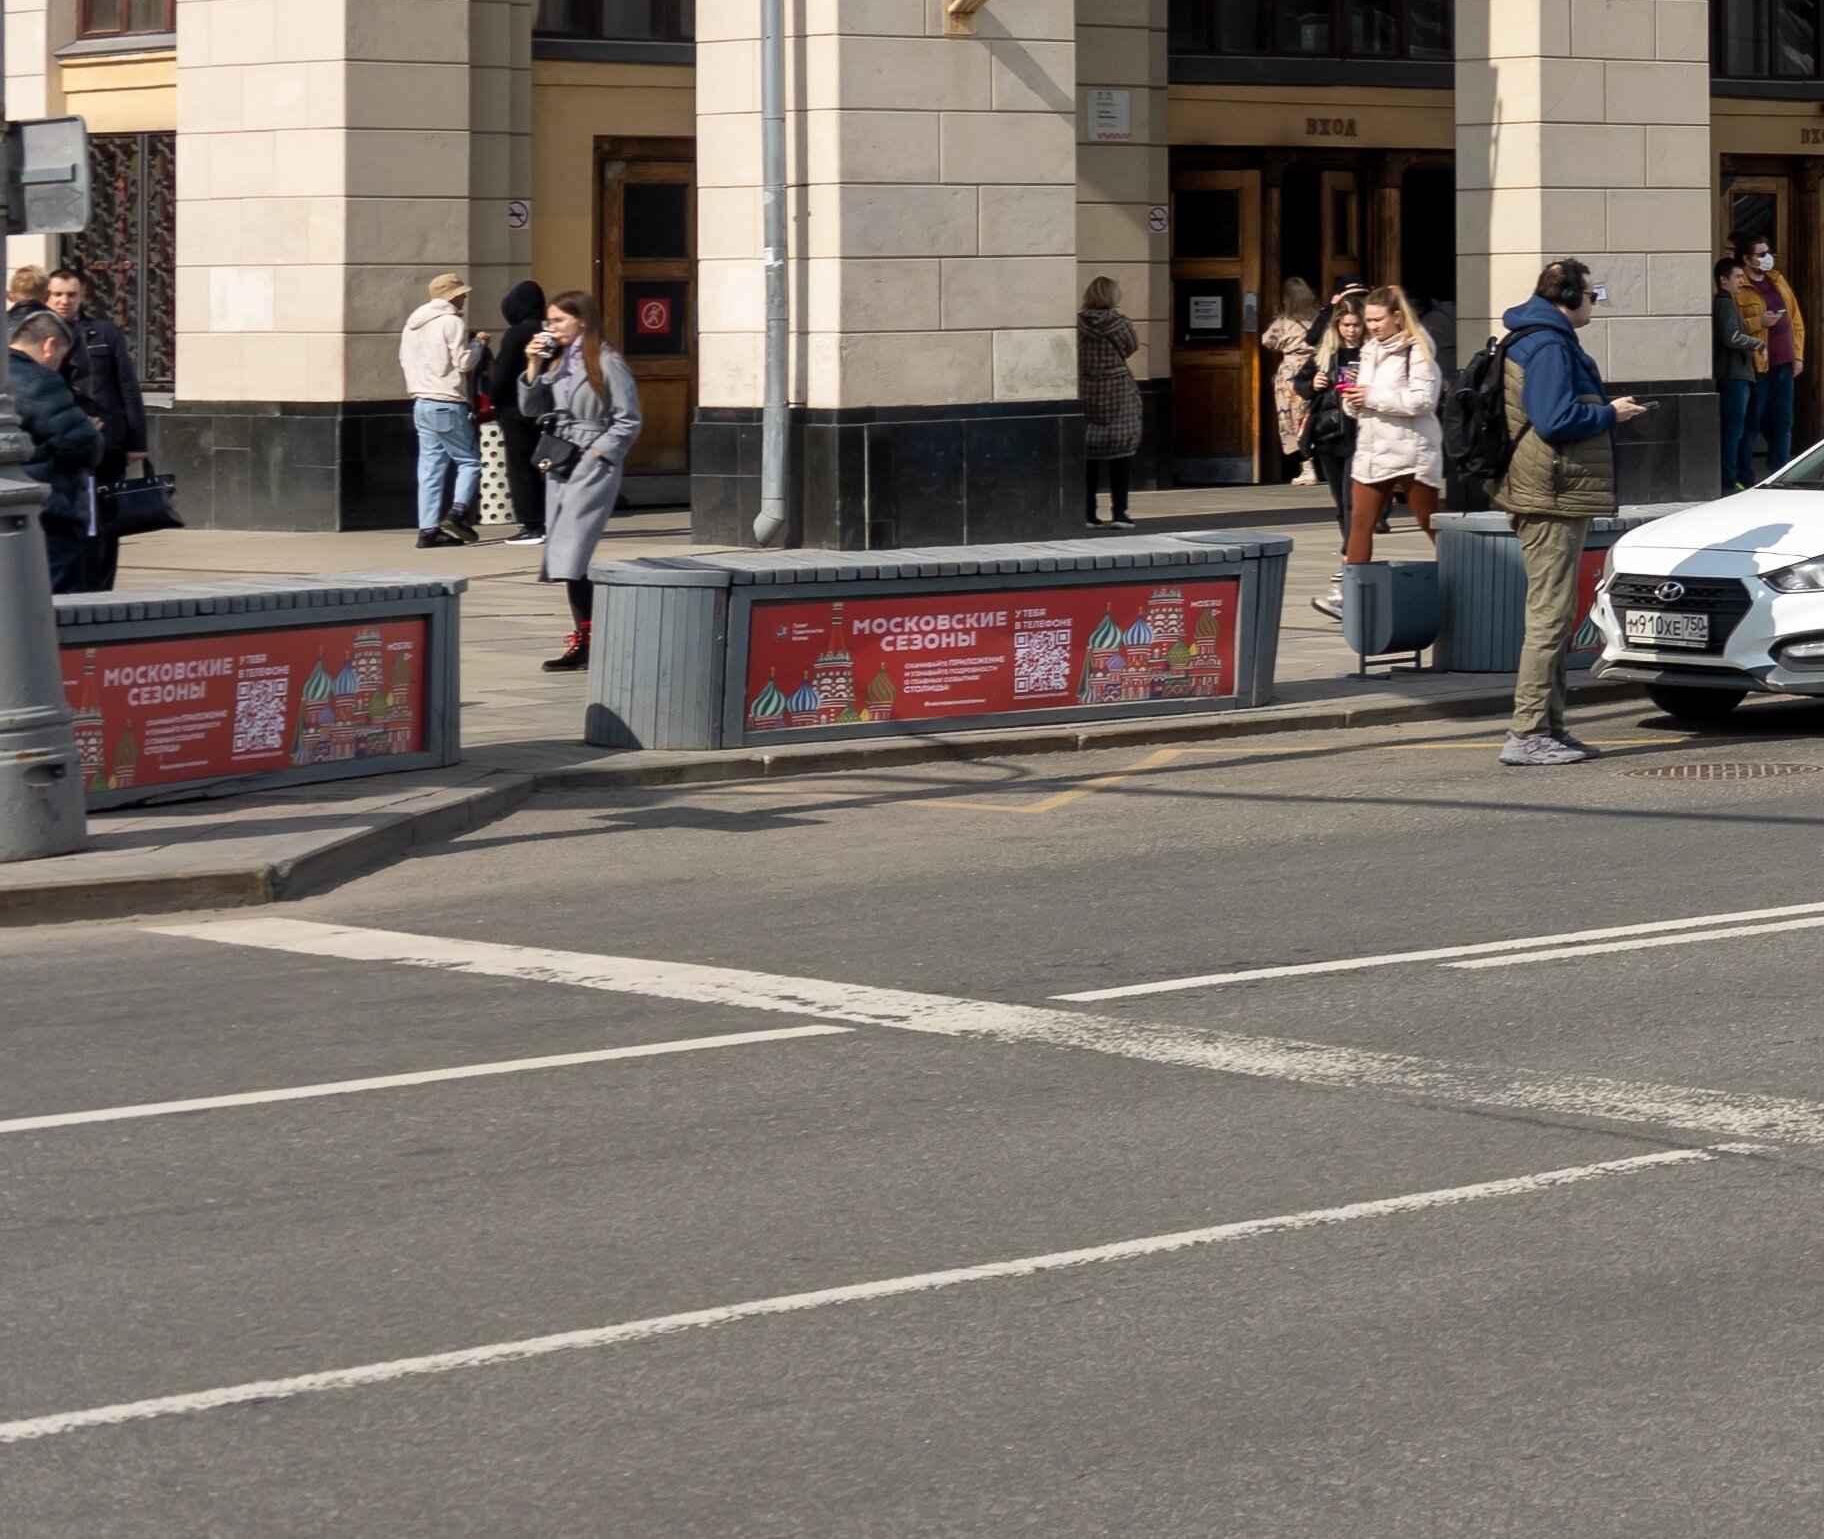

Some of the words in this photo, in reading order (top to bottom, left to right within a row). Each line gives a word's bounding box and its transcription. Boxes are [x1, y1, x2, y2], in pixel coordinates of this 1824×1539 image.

[1304, 117, 1358, 137] ВХОД
[852, 611, 1008, 636] МОСКОВСКИЕ
[1014, 610, 1021, 618] У
[1014, 621, 1021, 630] В
[1023, 618, 1073, 629] ТЕЛЕФОНЕ
[1627, 614, 1682, 637] М910ХЕ
[1683, 615, 1704, 632] 750
[879, 631, 977, 652] СЕЗОНЫ
[103, 657, 233, 688] МОСКОВСКИЕ
[126, 681, 207, 707] СЕЗОНЫ
